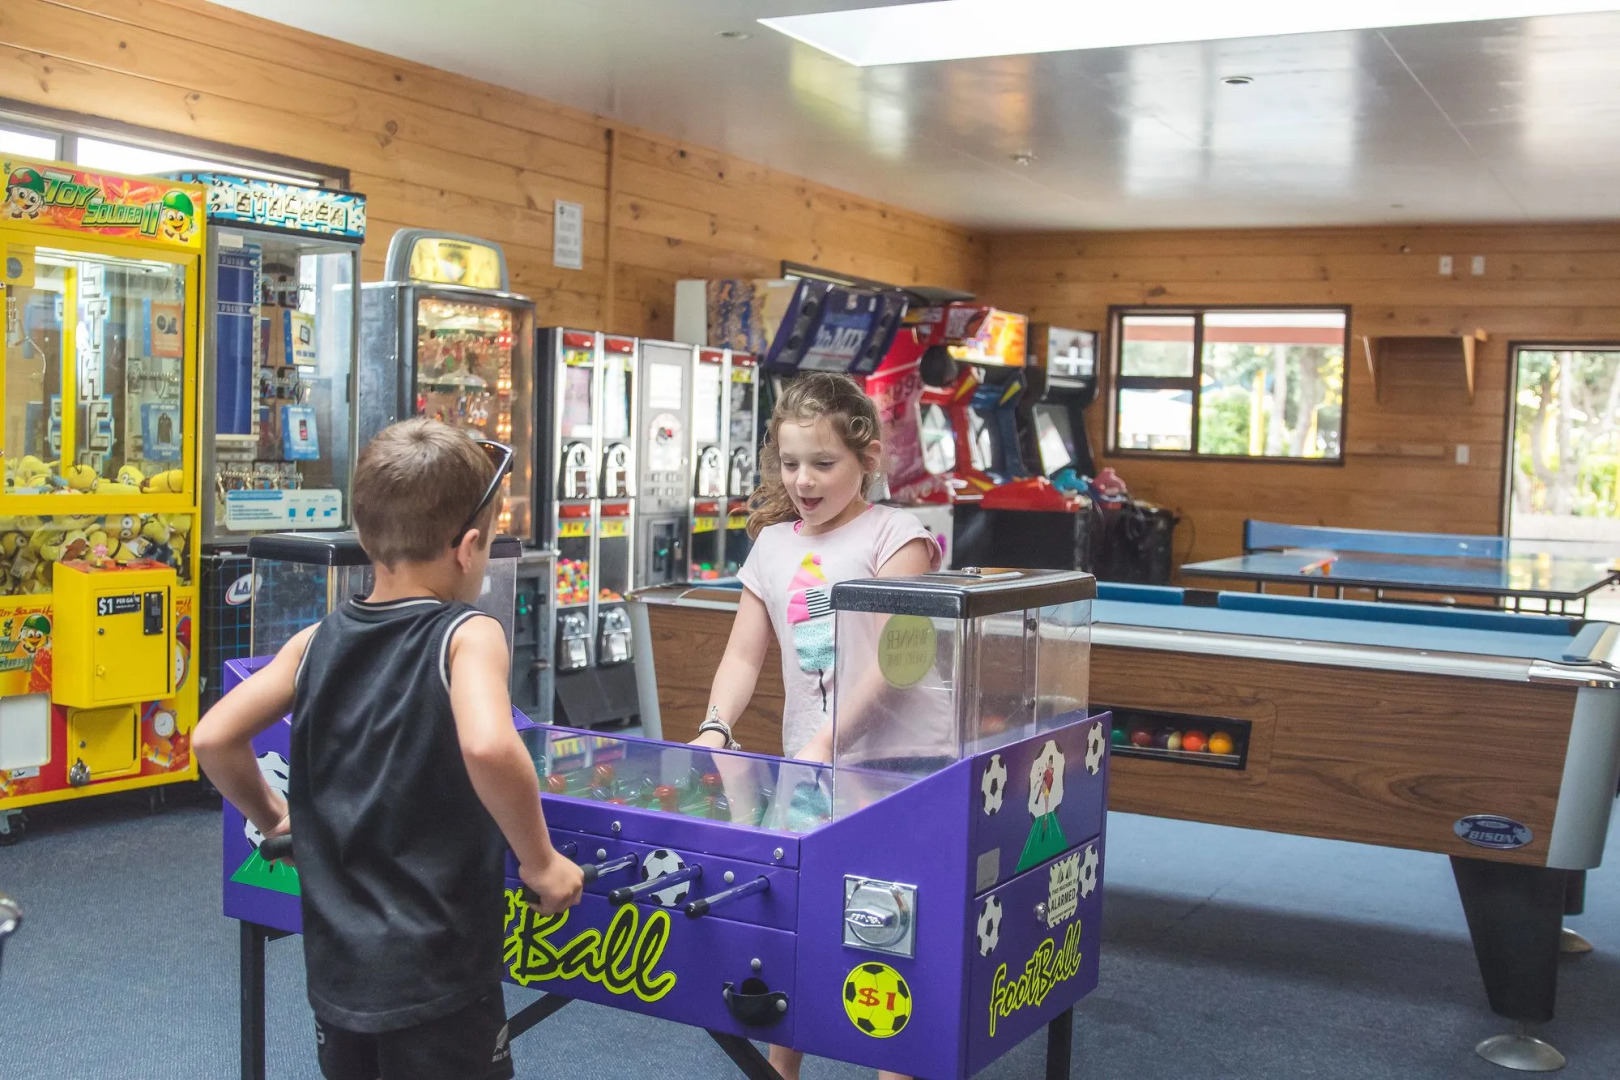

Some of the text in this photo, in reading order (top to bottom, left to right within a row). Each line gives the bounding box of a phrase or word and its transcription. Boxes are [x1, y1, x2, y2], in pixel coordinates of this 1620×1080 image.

[43, 169, 101, 208] TOY
[82, 198, 143, 227] SOLDIER
[98, 597, 114, 616] $1
[1468, 830, 1516, 844] BISON
[1050, 887, 1076, 912] ALARMED
